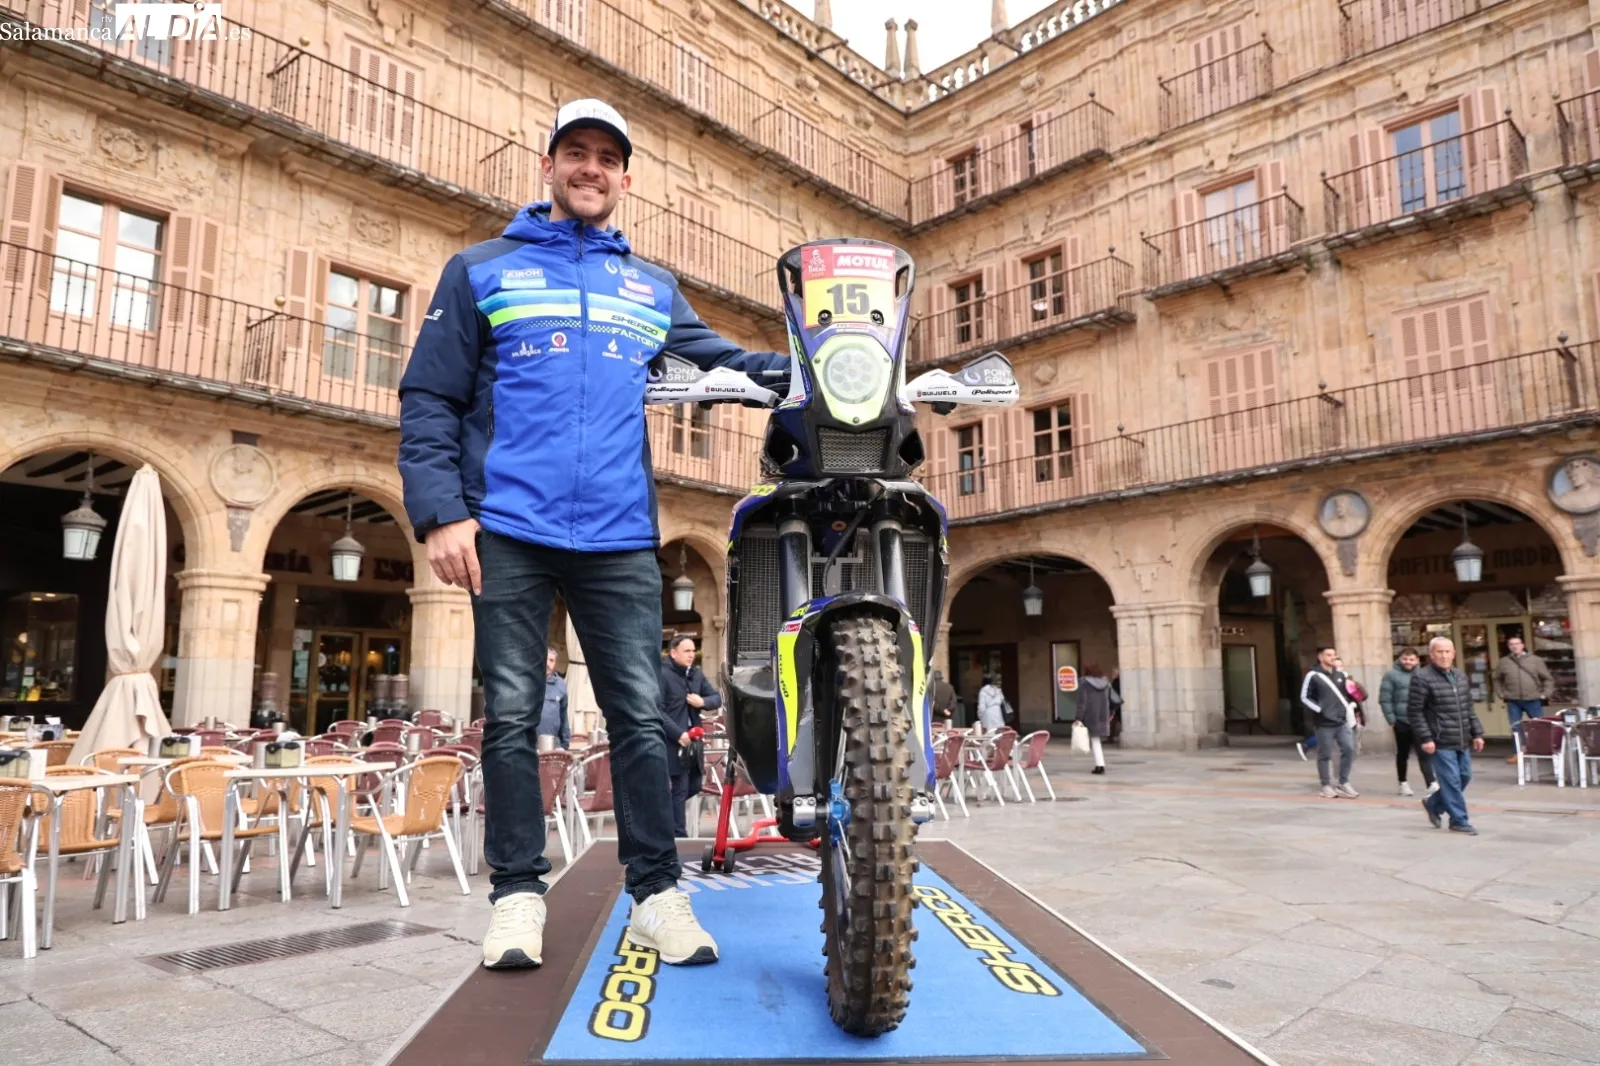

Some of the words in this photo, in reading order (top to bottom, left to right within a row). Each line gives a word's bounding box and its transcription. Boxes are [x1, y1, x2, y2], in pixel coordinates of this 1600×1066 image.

[836, 255, 890, 269] MOTUL
[826, 283, 870, 315] 15
[610, 314, 659, 336] SHERCO
[611, 326, 660, 351] FACTORY
